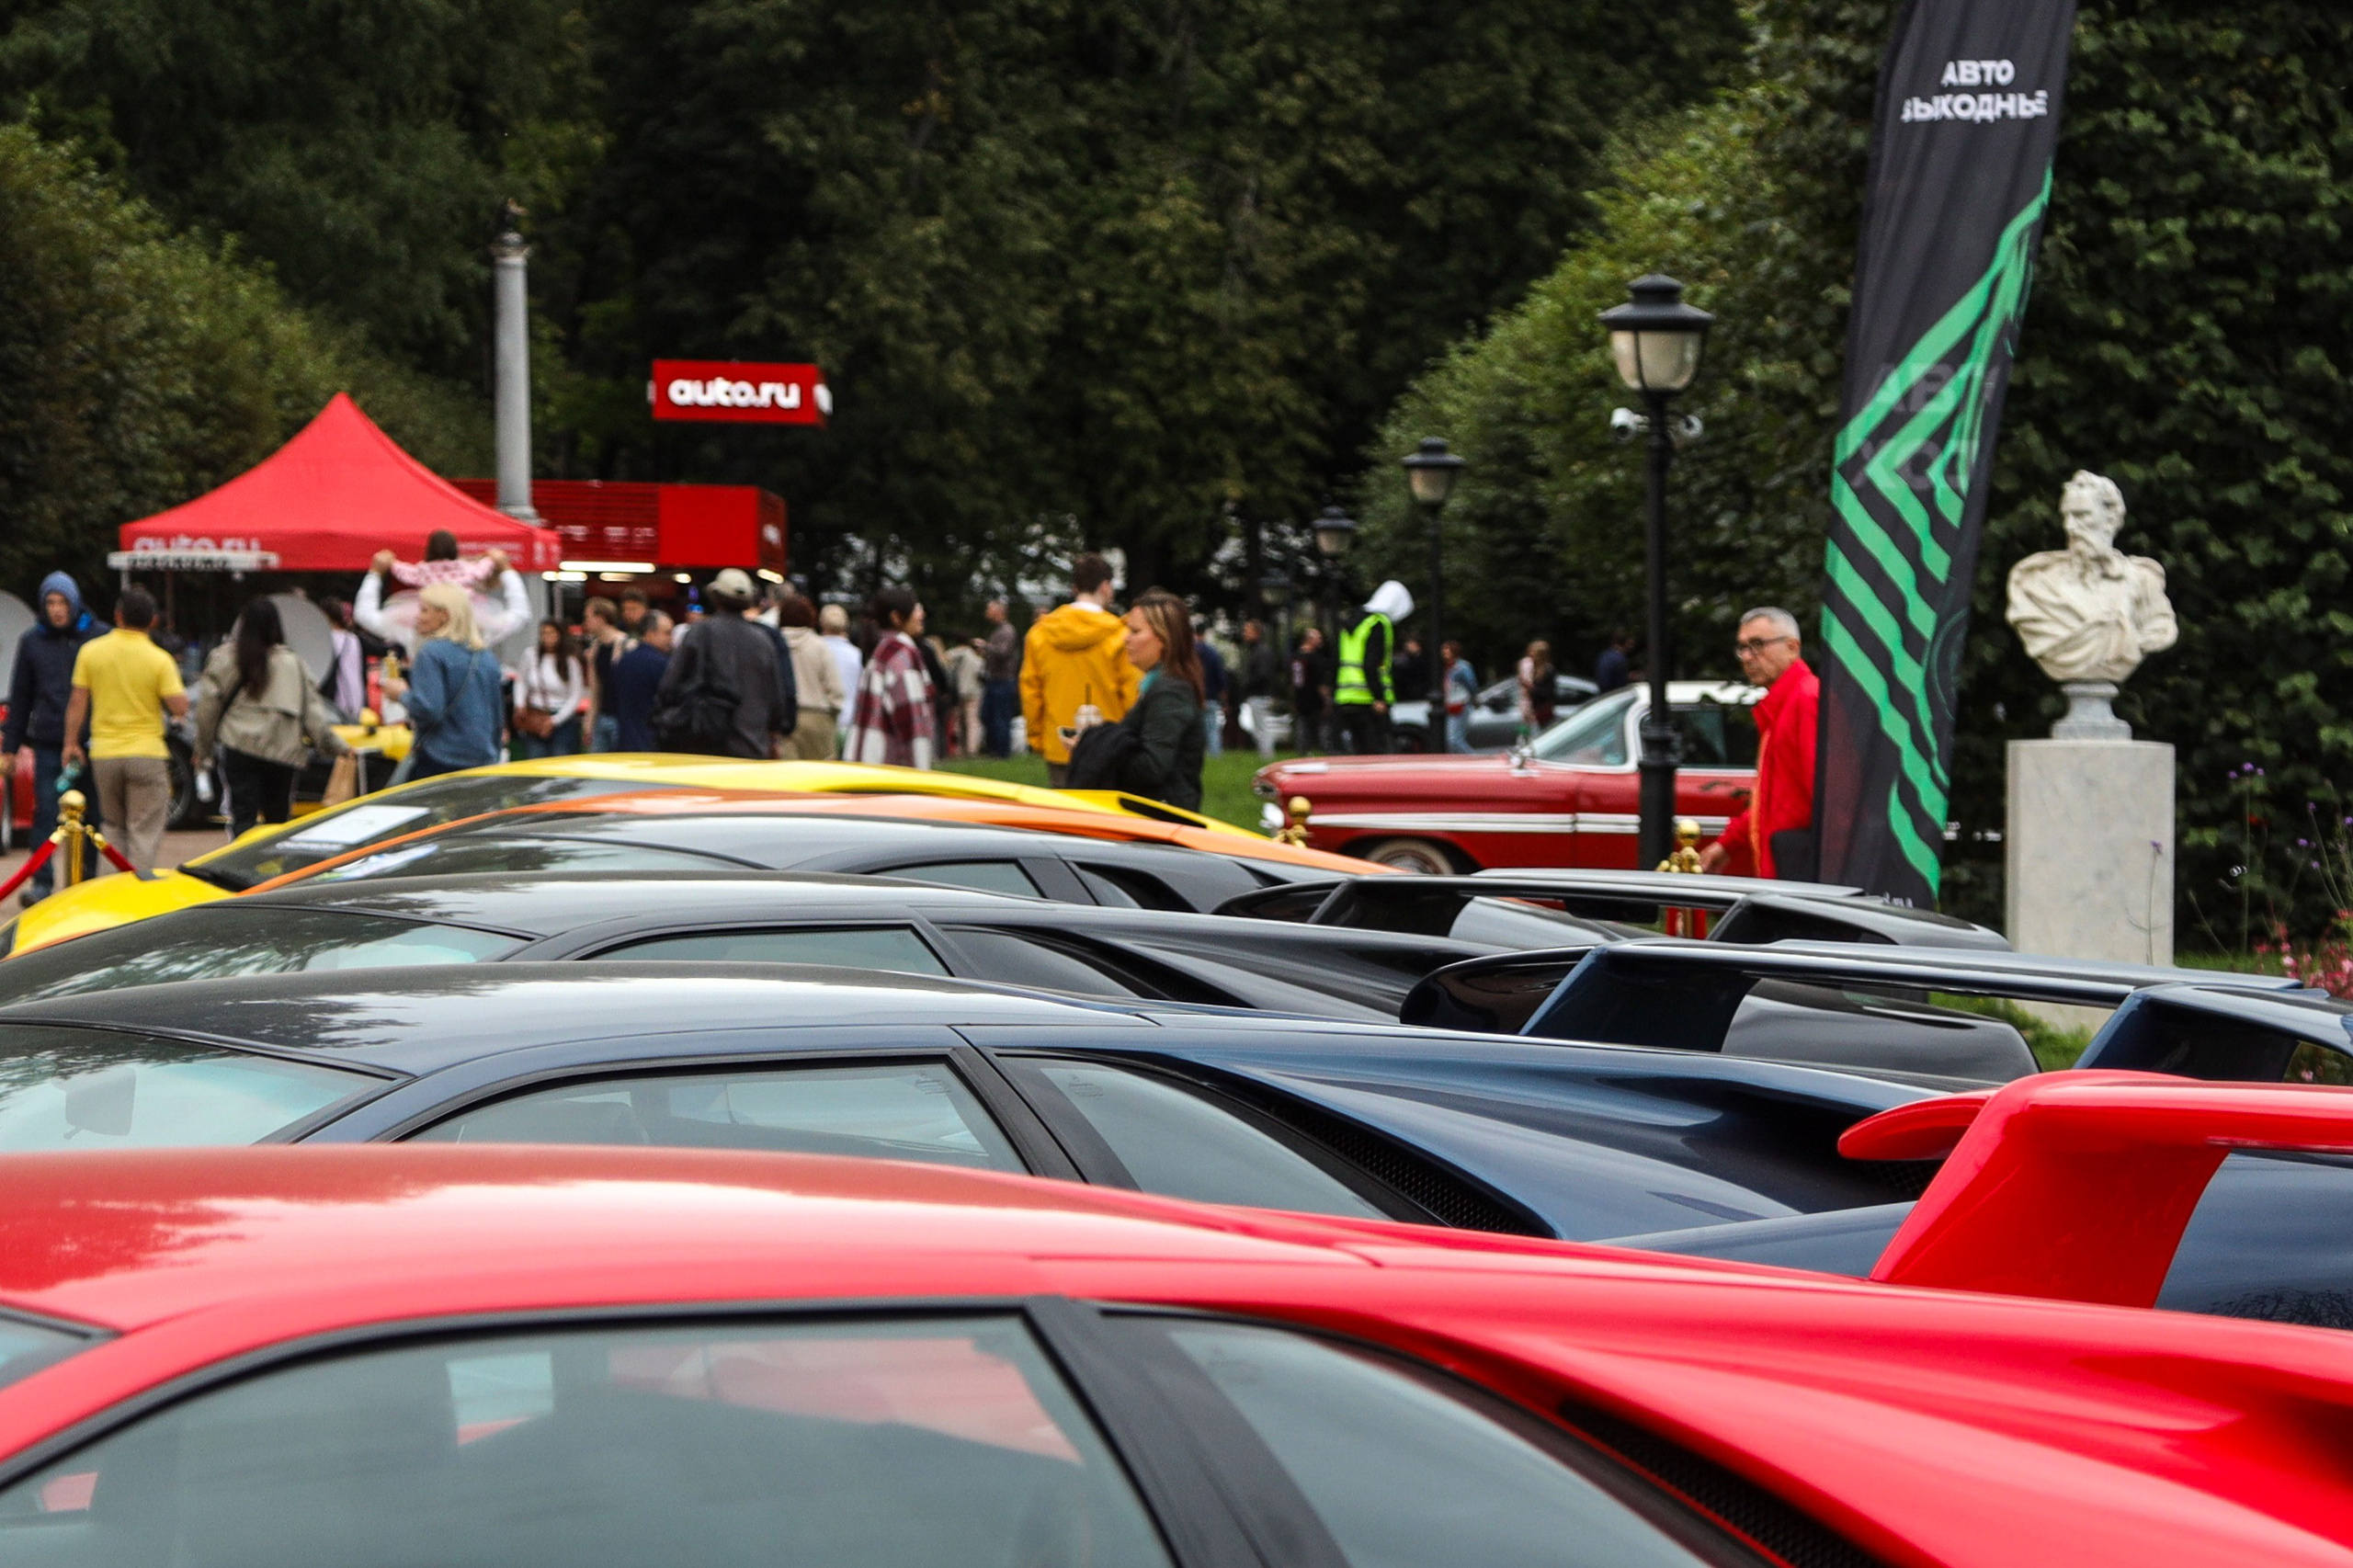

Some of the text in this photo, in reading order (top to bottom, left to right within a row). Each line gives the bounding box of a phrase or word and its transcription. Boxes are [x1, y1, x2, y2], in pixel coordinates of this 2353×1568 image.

[1940, 59, 2016, 86] АВТО
[667, 377, 801, 408] auto.ru
[133, 534, 261, 552] autoru
